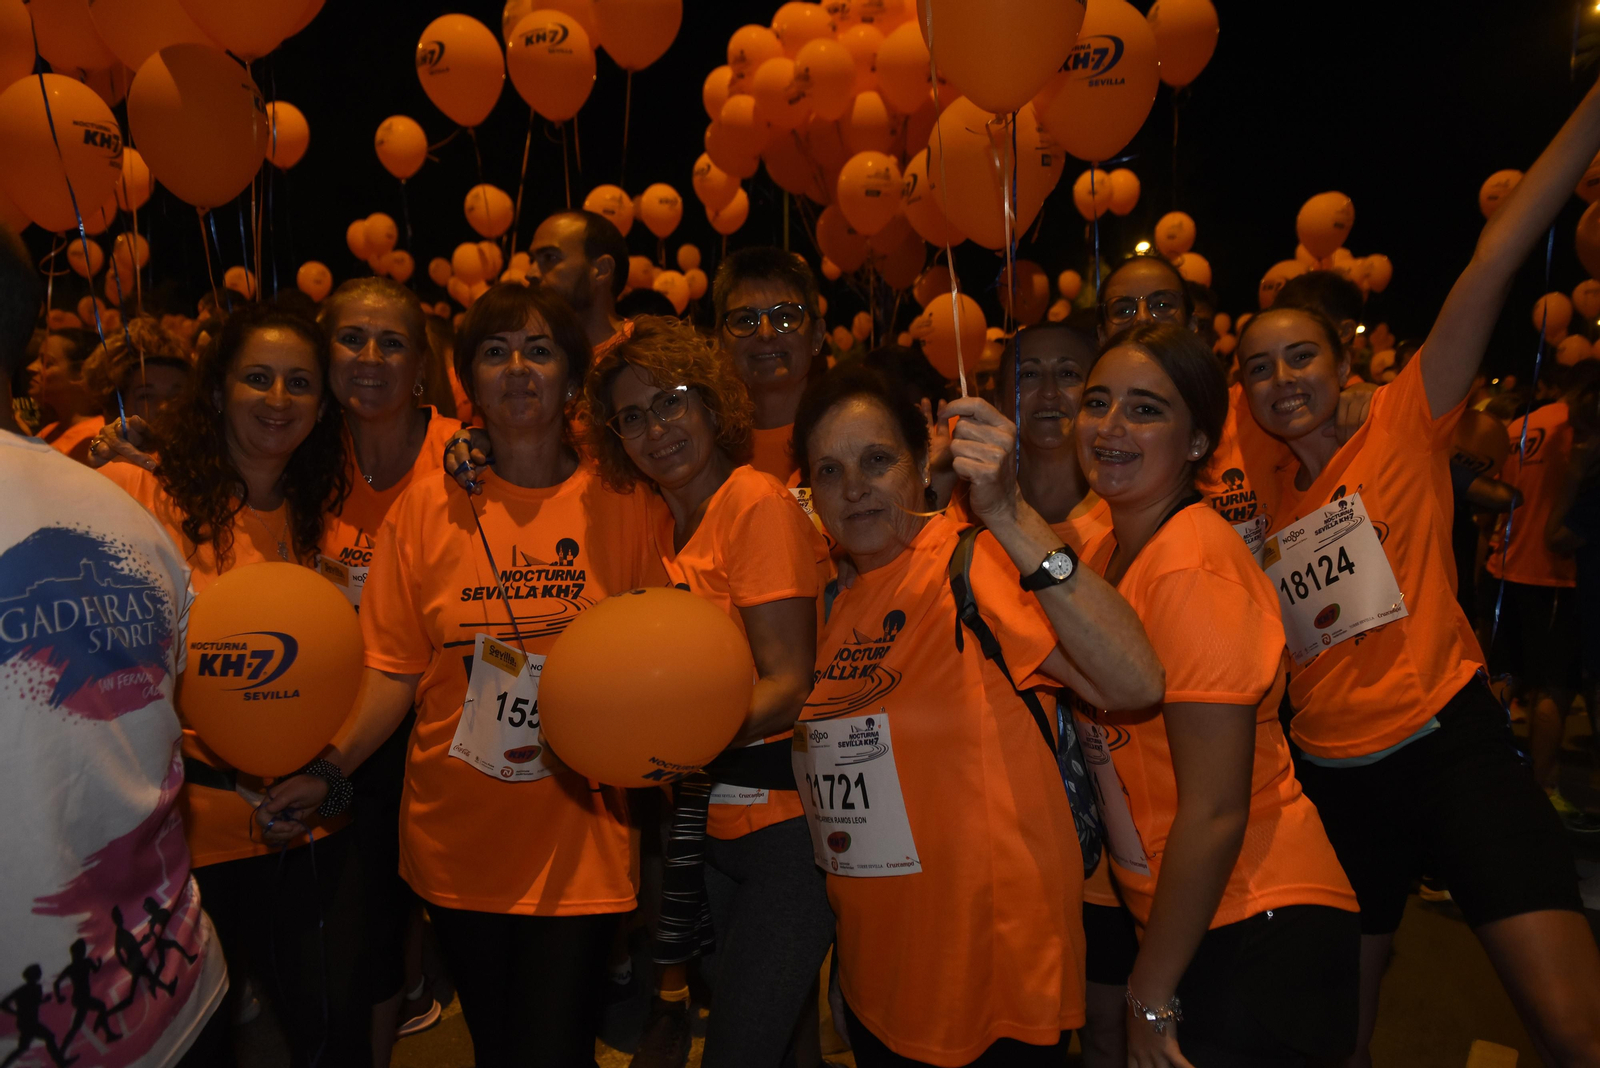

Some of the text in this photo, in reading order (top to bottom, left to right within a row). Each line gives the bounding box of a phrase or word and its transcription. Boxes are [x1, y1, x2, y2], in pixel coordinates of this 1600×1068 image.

[1088, 78, 1125, 87] SEVILLA
[500, 569, 586, 582] NOCTURNA
[1280, 546, 1355, 605] 18124
[460, 585, 538, 602] SEVILLA
[0, 590, 155, 644] GADEIRAS
[88, 621, 155, 654] SPORT
[190, 642, 248, 651] NOCTURNA
[243, 689, 300, 701] SEVILLA
[849, 731, 879, 740] NOCTURNA
[838, 740, 863, 748] SEVILLA
[806, 772, 870, 810] 21721
[834, 816, 851, 824] RAMOS
[852, 816, 867, 824] LEON
[886, 860, 915, 868] Cruzcampo
